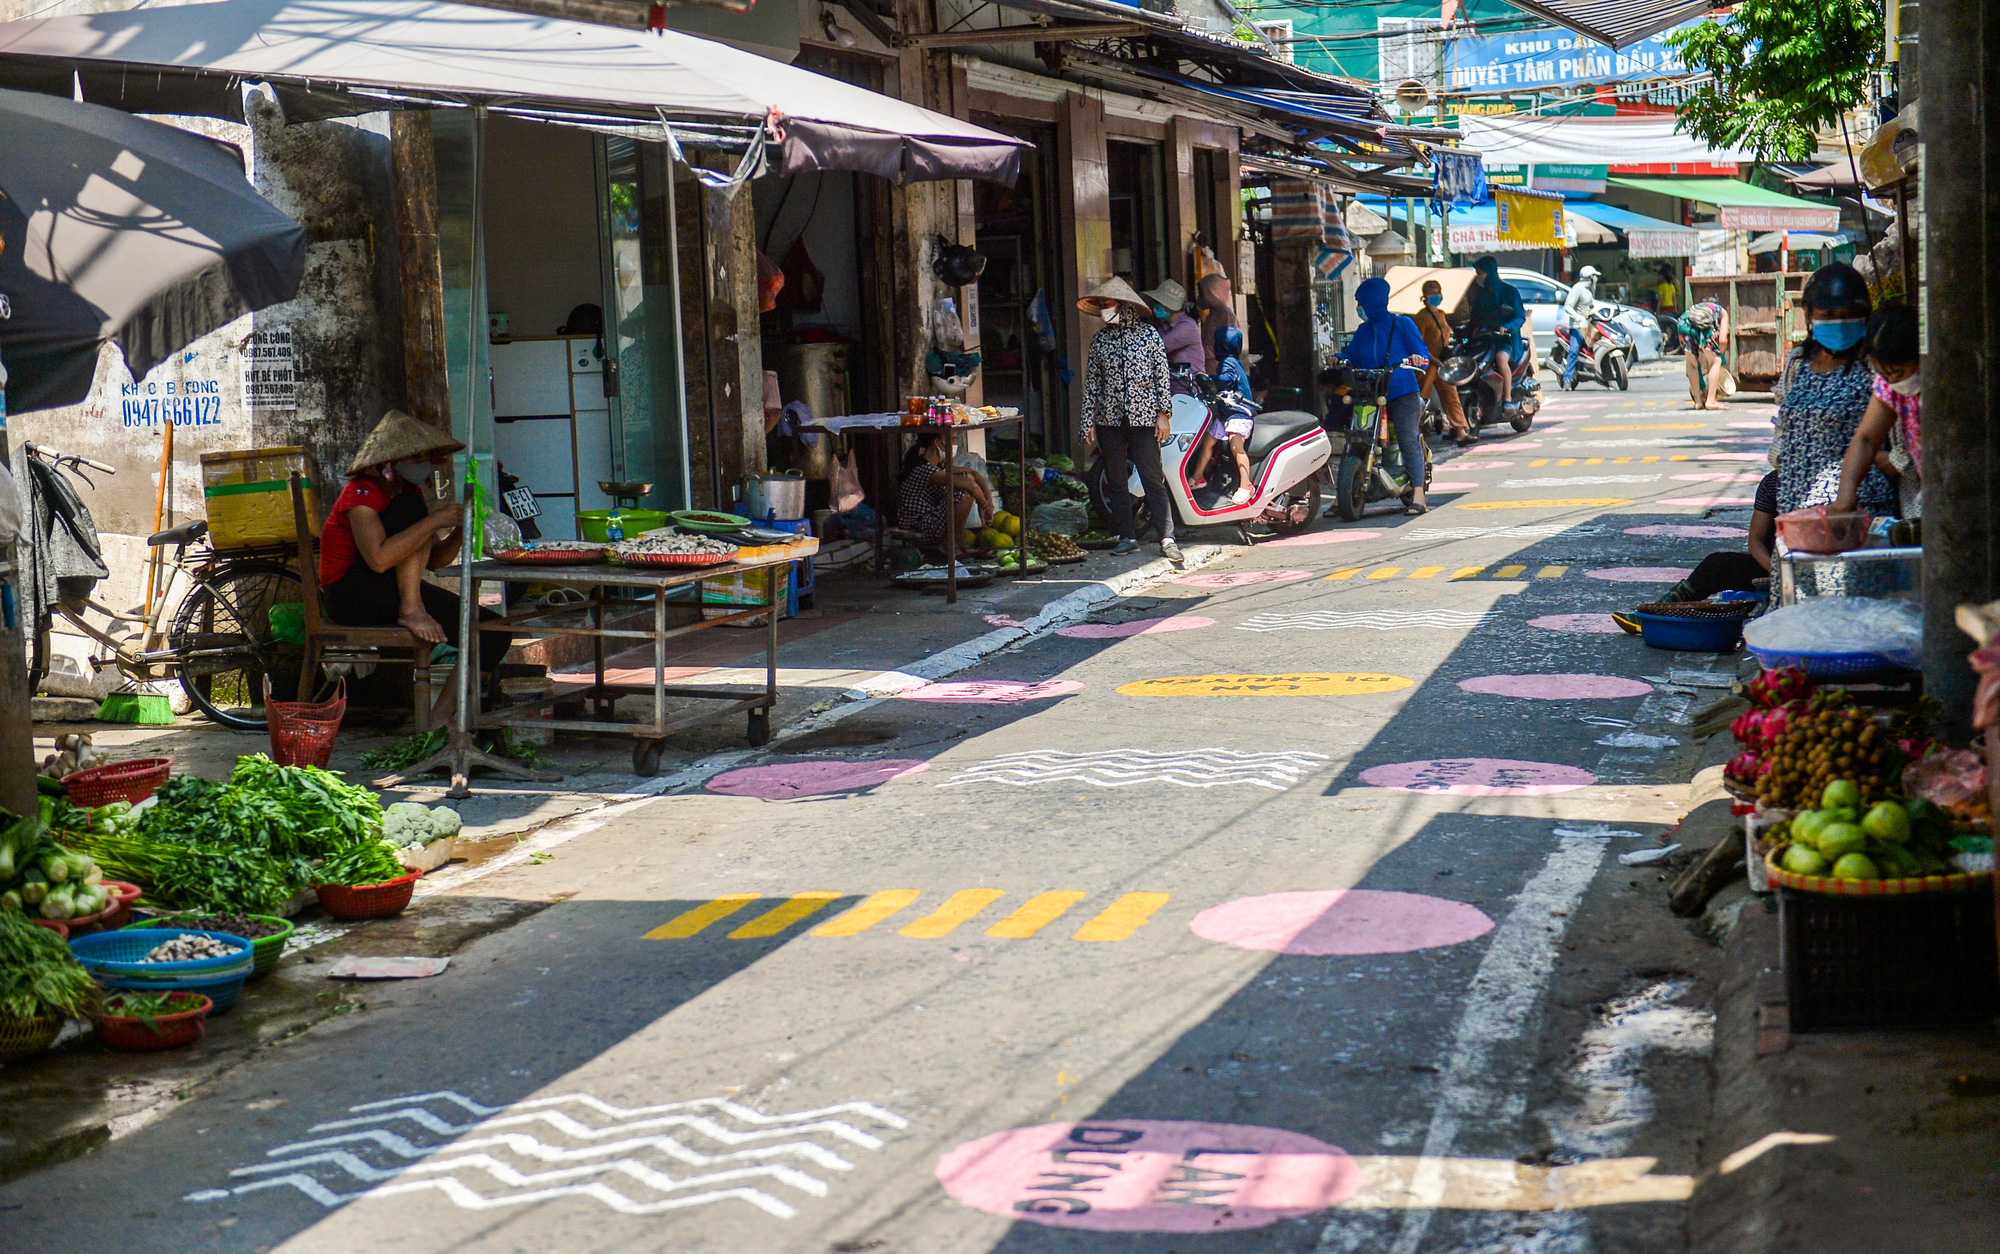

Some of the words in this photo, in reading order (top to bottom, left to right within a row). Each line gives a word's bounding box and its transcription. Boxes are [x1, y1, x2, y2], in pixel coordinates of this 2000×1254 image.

[1505, 40, 1550, 55] KHU
[1514, 58, 1554, 83] TÂM
[1559, 49, 1611, 79] PHẤN
[1615, 45, 1655, 74] ĐẤU
[1452, 227, 1476, 243] CHẢ
[512, 501, 539, 518] 076.41
